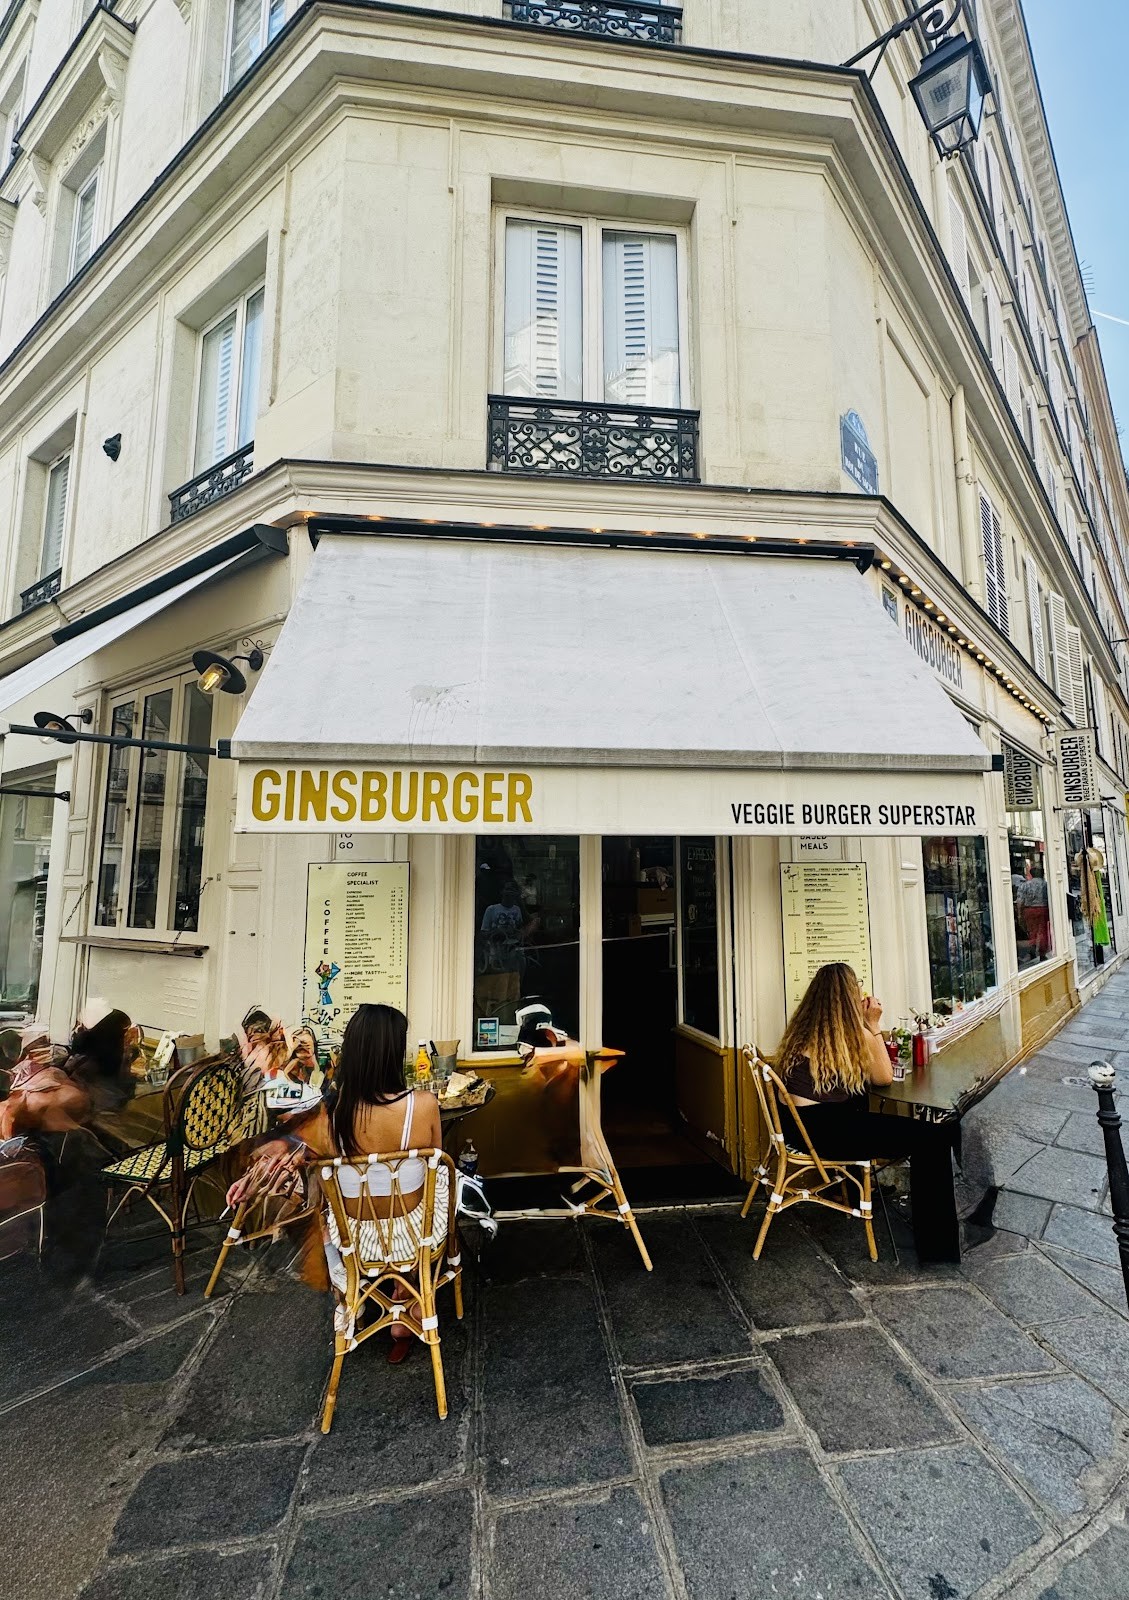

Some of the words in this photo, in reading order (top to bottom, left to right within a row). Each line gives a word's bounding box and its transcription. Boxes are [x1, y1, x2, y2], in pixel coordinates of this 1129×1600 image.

[904, 604, 963, 689] GINSBURGER
[1078, 735, 1088, 767] SUPERSTAR
[1060, 736, 1083, 802] GINSBURGER
[1081, 767, 1090, 802] VEGETARIAN
[252, 769, 533, 823] GINSBURGER
[731, 803, 795, 825] VEGGIE
[803, 804, 871, 825] BURGER
[879, 805, 976, 826] SUPERSTAR
[338, 841, 354, 850] GO
[800, 842, 829, 850] MEALS
